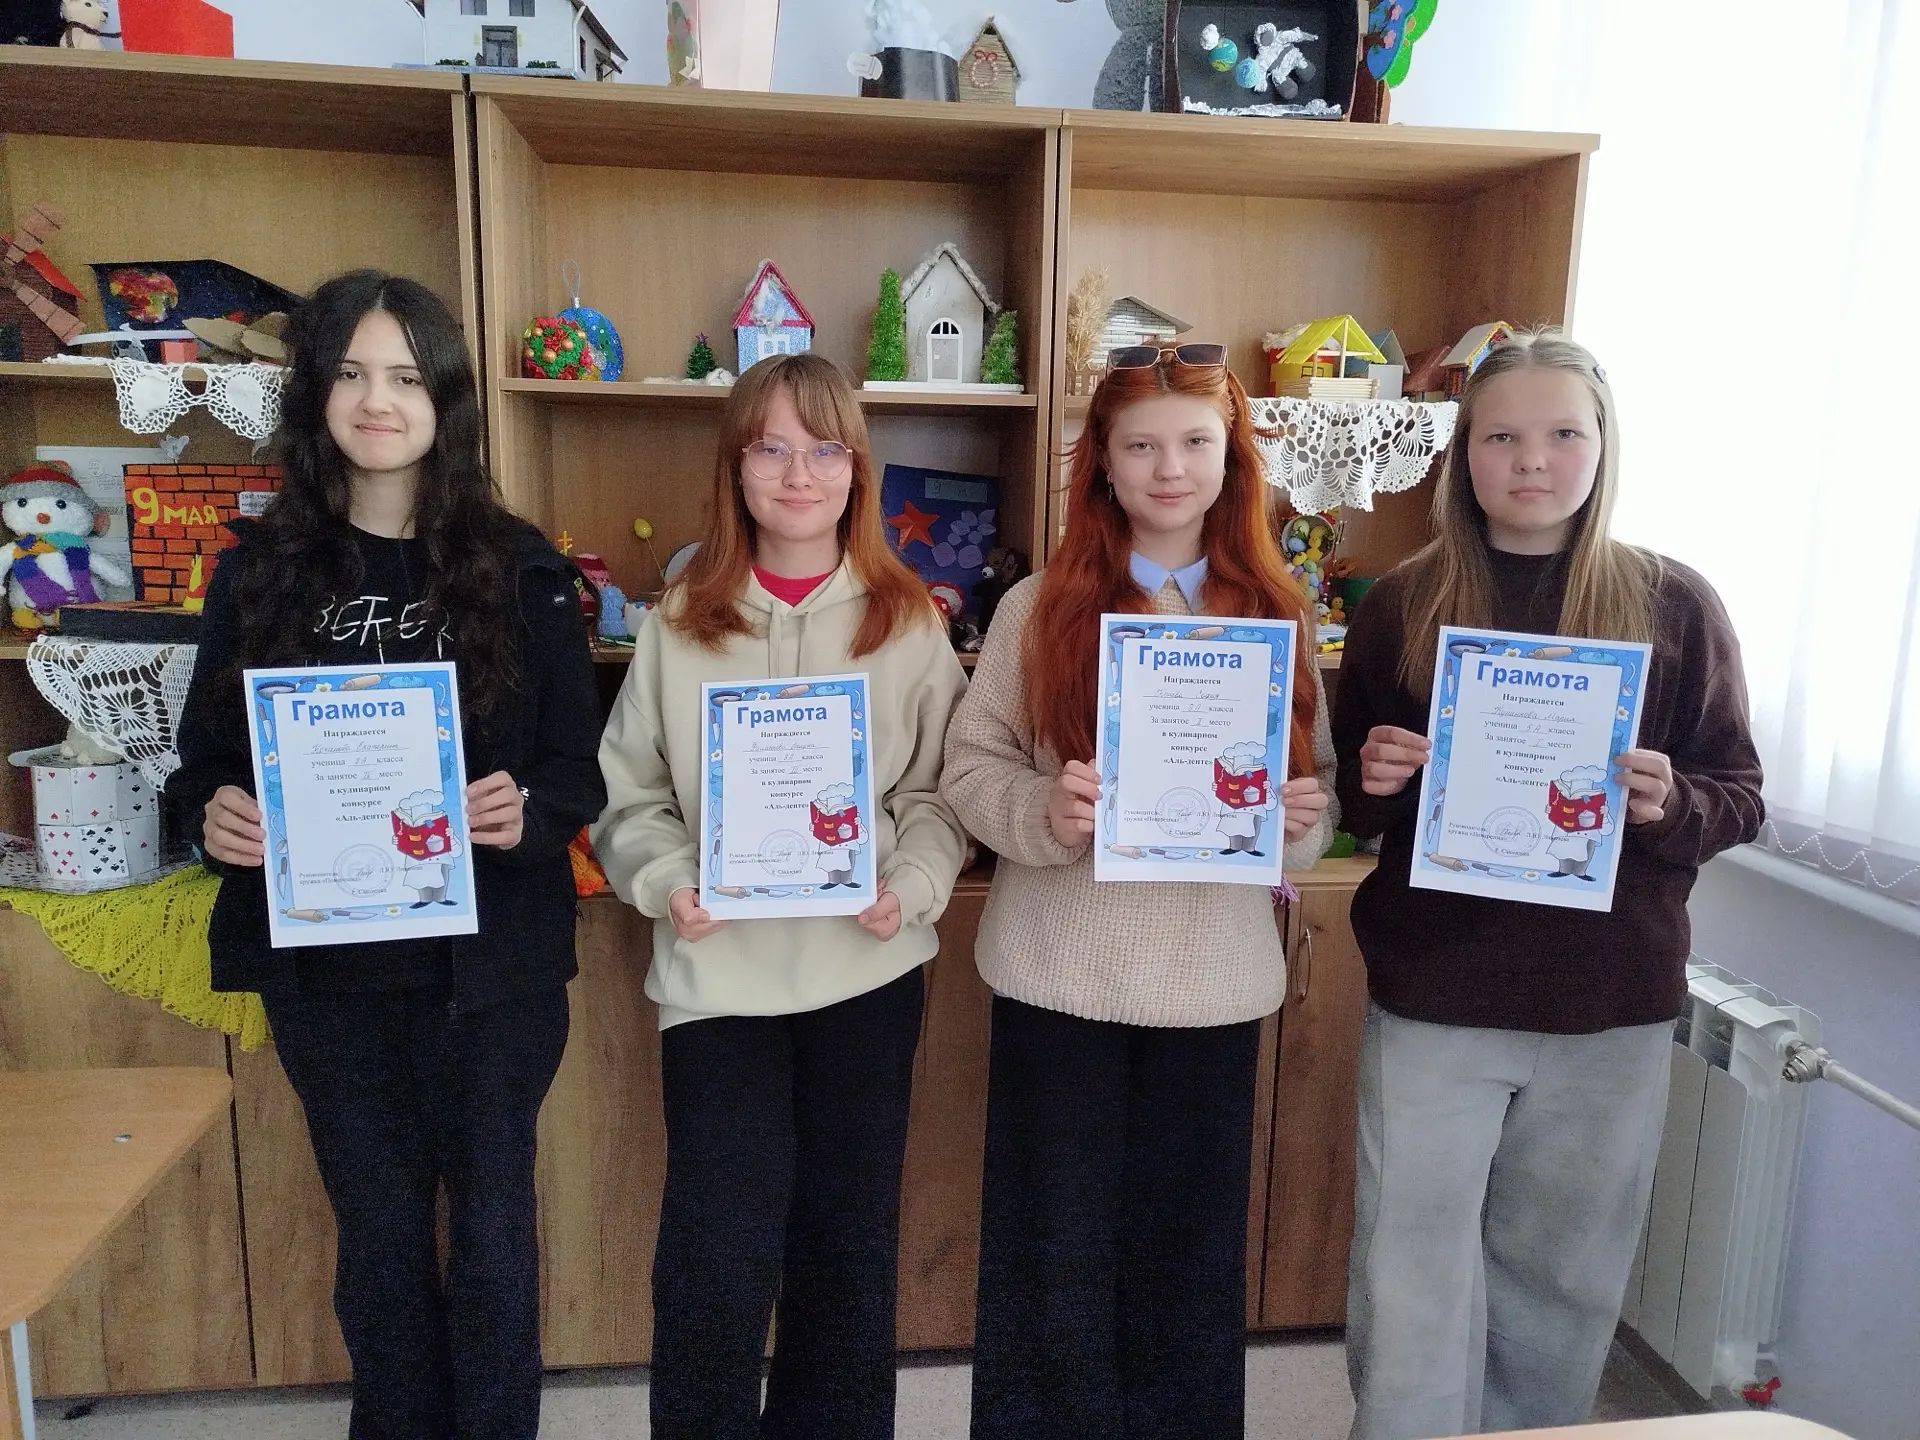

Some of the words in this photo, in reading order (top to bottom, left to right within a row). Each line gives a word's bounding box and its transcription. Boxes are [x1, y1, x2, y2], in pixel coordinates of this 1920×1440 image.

[132, 487, 159, 524] 9
[163, 504, 219, 525] МАЯ
[1139, 645, 1242, 670] Грамота
[1163, 675, 1221, 685] Награждается
[1476, 660, 1589, 691] Грамота
[1502, 693, 1564, 707] Награждается
[291, 700, 406, 726] Грамота
[737, 706, 828, 728] Грамота
[1150, 716, 1159, 724] За
[1484, 720, 1518, 730] ученица
[1548, 727, 1575, 735] класса
[323, 728, 386, 739] Награждается
[760, 730, 811, 739] Награждается
[1168, 731, 1218, 740] кулинарном
[1496, 735, 1527, 744] занятое
[1548, 741, 1572, 749] место
[1170, 744, 1208, 753] конкурсе
[1503, 750, 1556, 761] кулинарном
[311, 759, 346, 768] ученица
[1504, 762, 1544, 774] конкурсе
[315, 773, 324, 781] За
[337, 784, 391, 796] кулинарном
[341, 799, 382, 809] конкурсе
